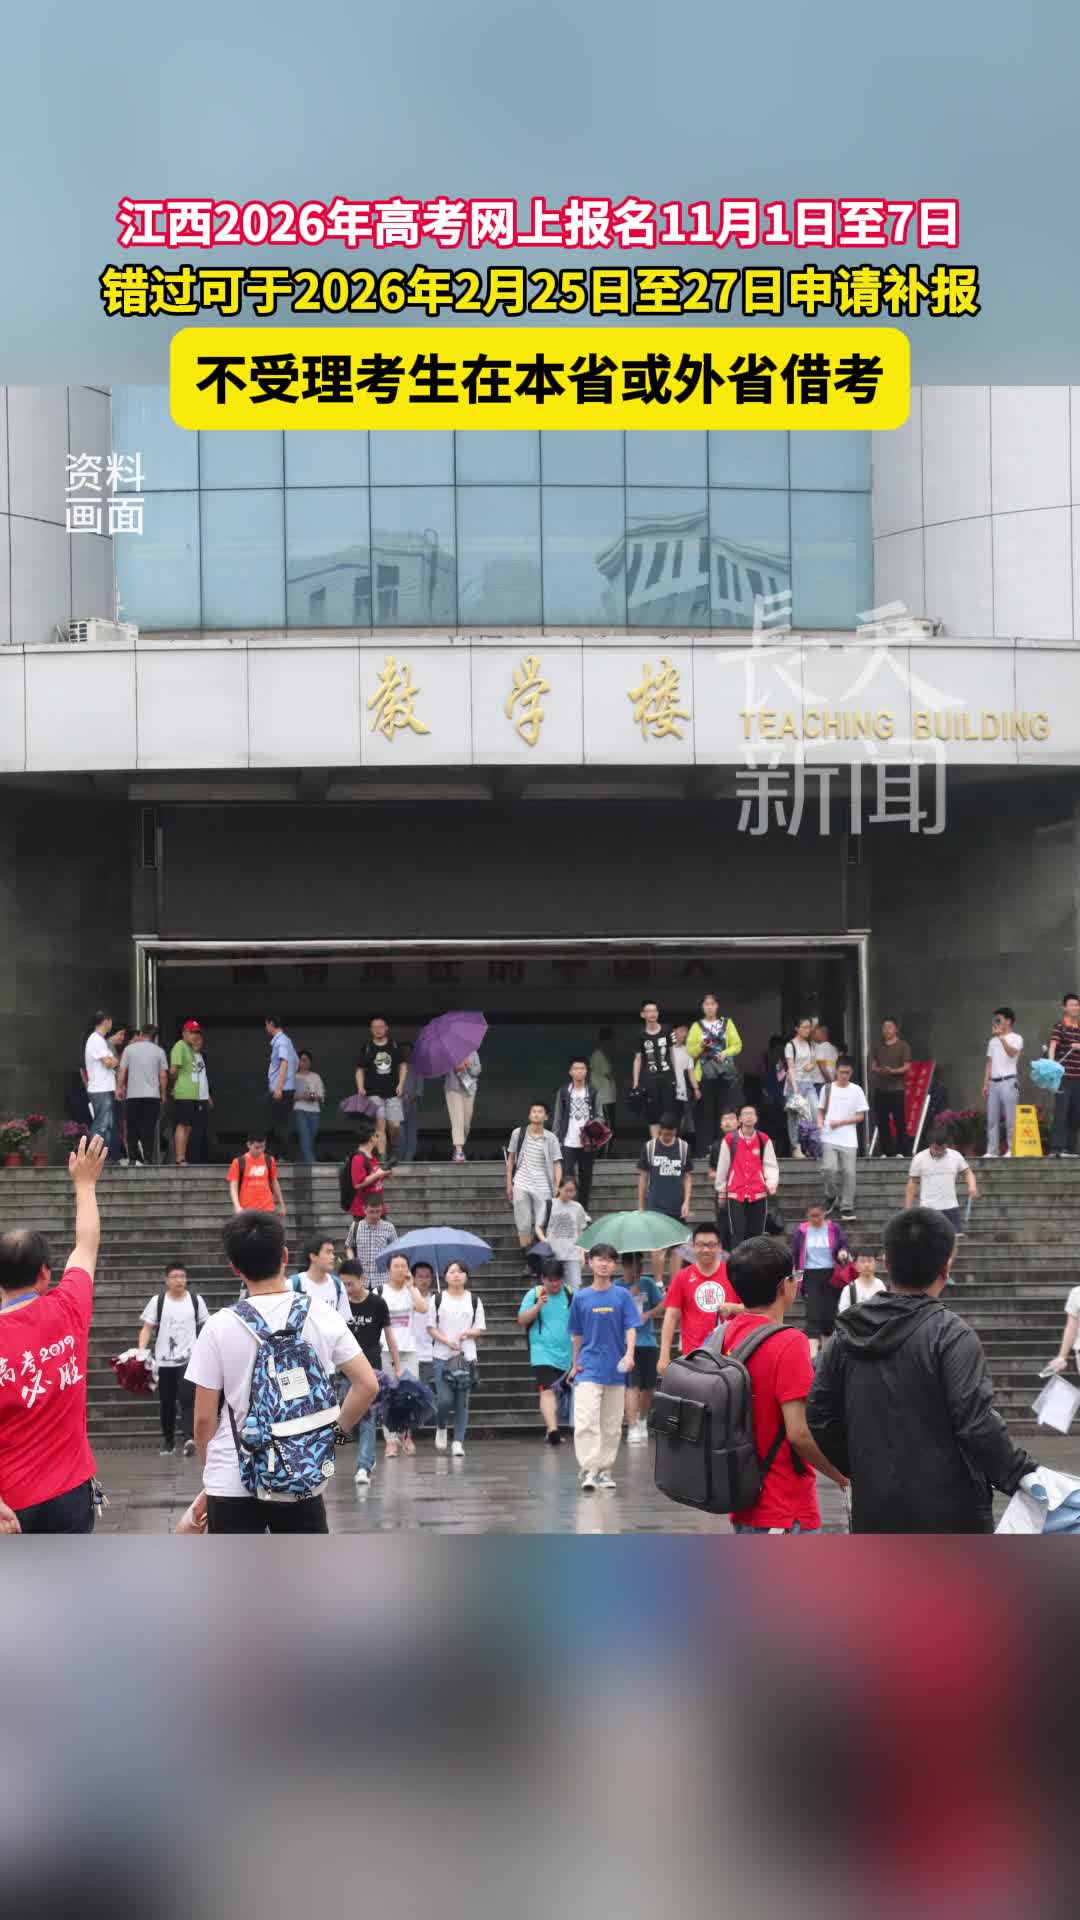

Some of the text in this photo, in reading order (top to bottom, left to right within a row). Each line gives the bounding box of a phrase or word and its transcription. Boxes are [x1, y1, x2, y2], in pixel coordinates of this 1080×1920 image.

[367, 655, 690, 746] 教学楼
[739, 710, 1050, 739] TEACHING BUILDING
